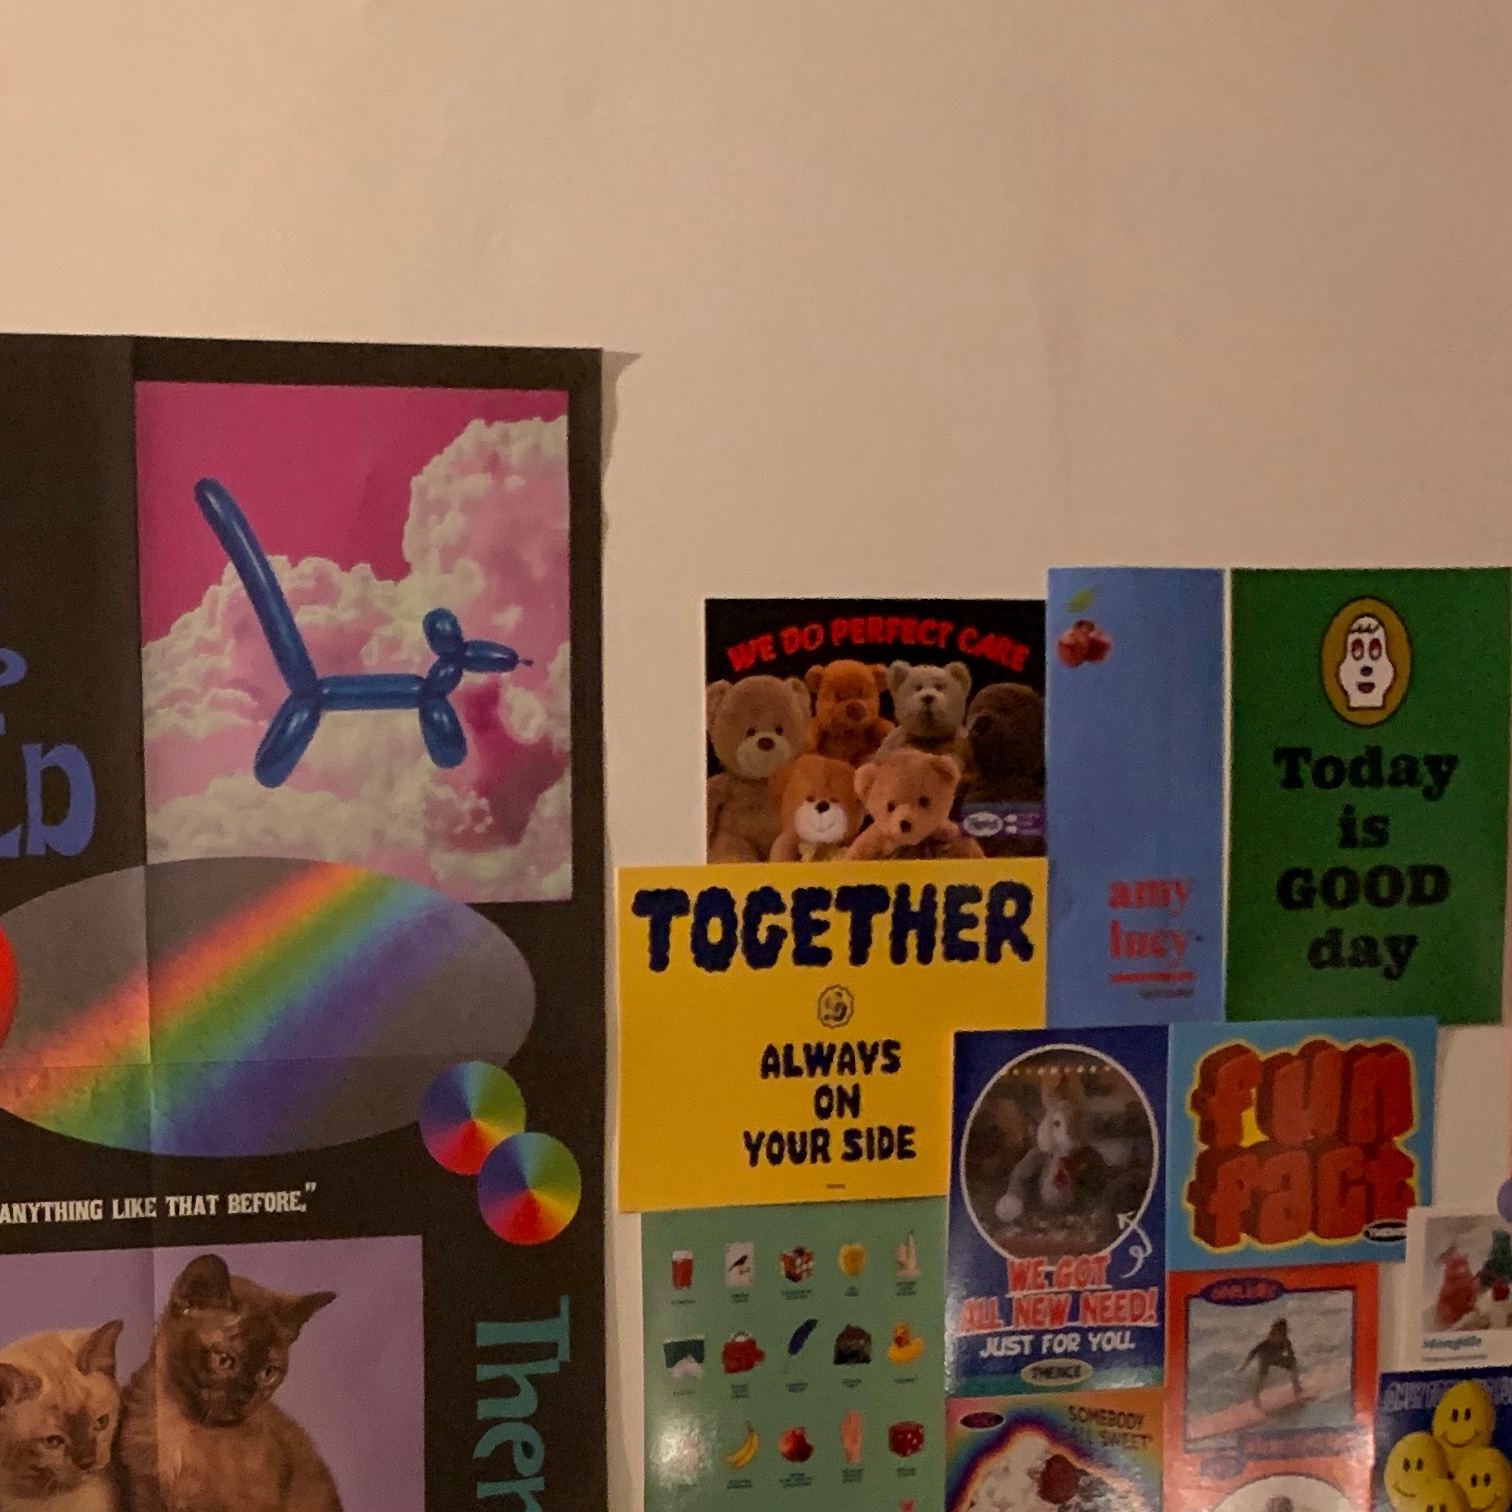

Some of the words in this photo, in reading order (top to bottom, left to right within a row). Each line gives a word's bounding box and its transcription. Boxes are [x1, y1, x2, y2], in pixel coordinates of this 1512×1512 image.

[728, 634, 777, 672] WE
[780, 623, 824, 655] DO
[831, 616, 953, 648] PERFECT
[957, 627, 1030, 673] CARE
[1273, 746, 1459, 801] Today
[1338, 805, 1390, 849] is
[1276, 864, 1451, 910] GOOD
[632, 880, 1034, 973] TOGETHER
[1307, 928, 1418, 982] day
[760, 1039, 902, 1080] ALWAYS
[813, 1083, 861, 1120] ON
[743, 1127, 831, 1168] YOUR
[841, 1125, 917, 1162] SIDE
[111, 1196, 157, 1219] LIKE
[166, 1194, 220, 1218] THAT
[1006, 1257, 1048, 1291] WE
[1053, 1252, 1111, 1289] GOT
[1012, 1294, 1072, 1329] NEW
[1079, 1286, 1159, 1327] NEED!
[979, 1335, 1034, 1358] JUST
[1041, 1333, 1082, 1354] FOR
[1068, 1405, 1145, 1430] SOMEBODY
